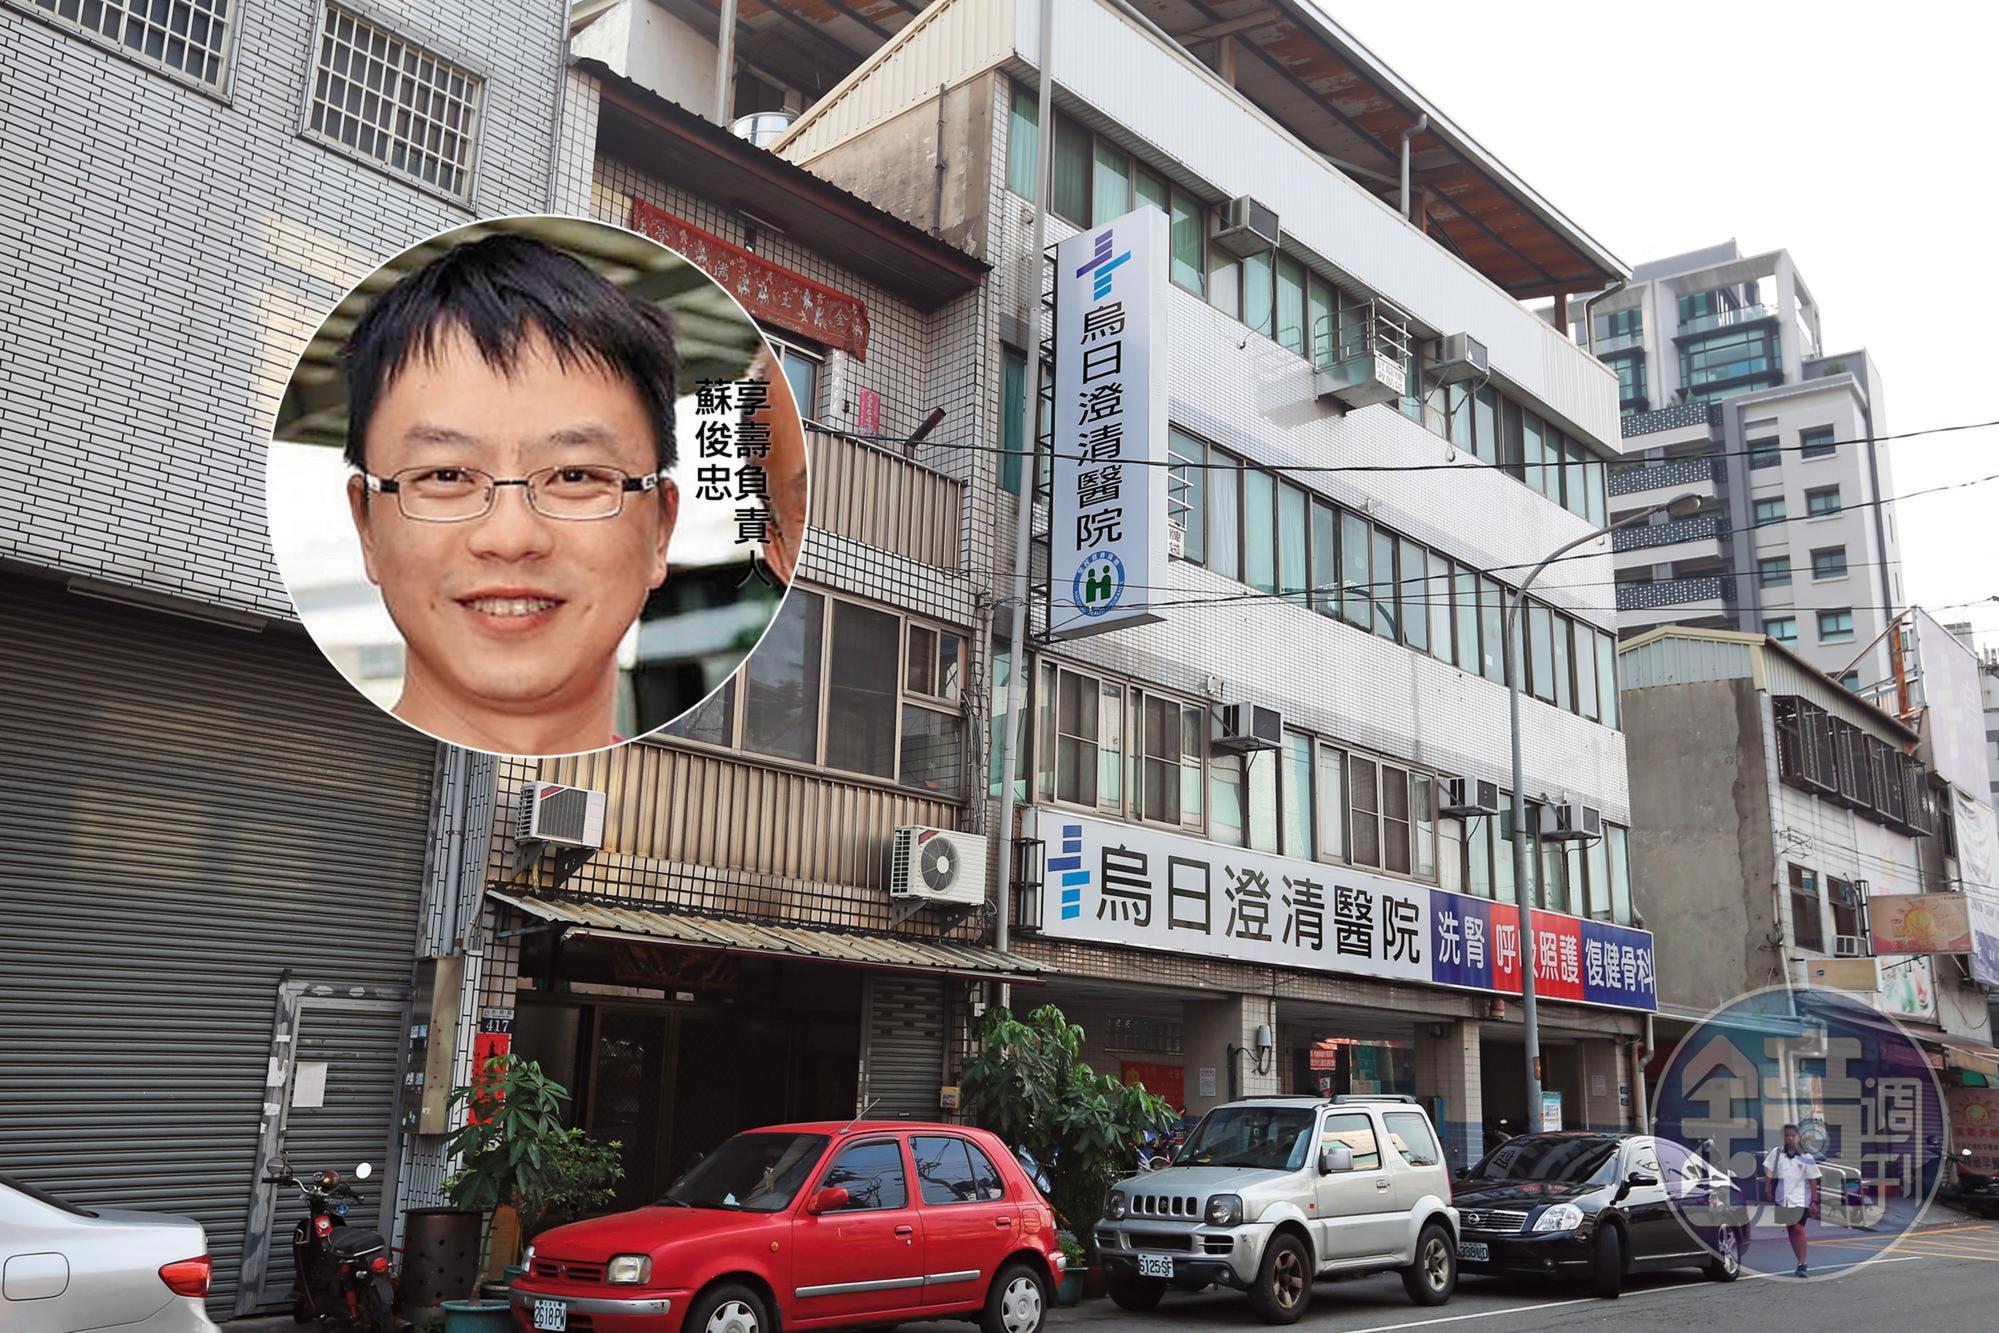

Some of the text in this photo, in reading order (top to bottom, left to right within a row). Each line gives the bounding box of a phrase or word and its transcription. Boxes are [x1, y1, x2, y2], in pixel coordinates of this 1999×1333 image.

[1077, 301, 1126, 551] 烏日澄清醫院
[1096, 844, 1420, 964] 烏日澄清醫院
[1438, 911, 1485, 970] 洗腎
[1585, 938, 1654, 994] 復健骨科
[486, 1019, 509, 1032] 417
